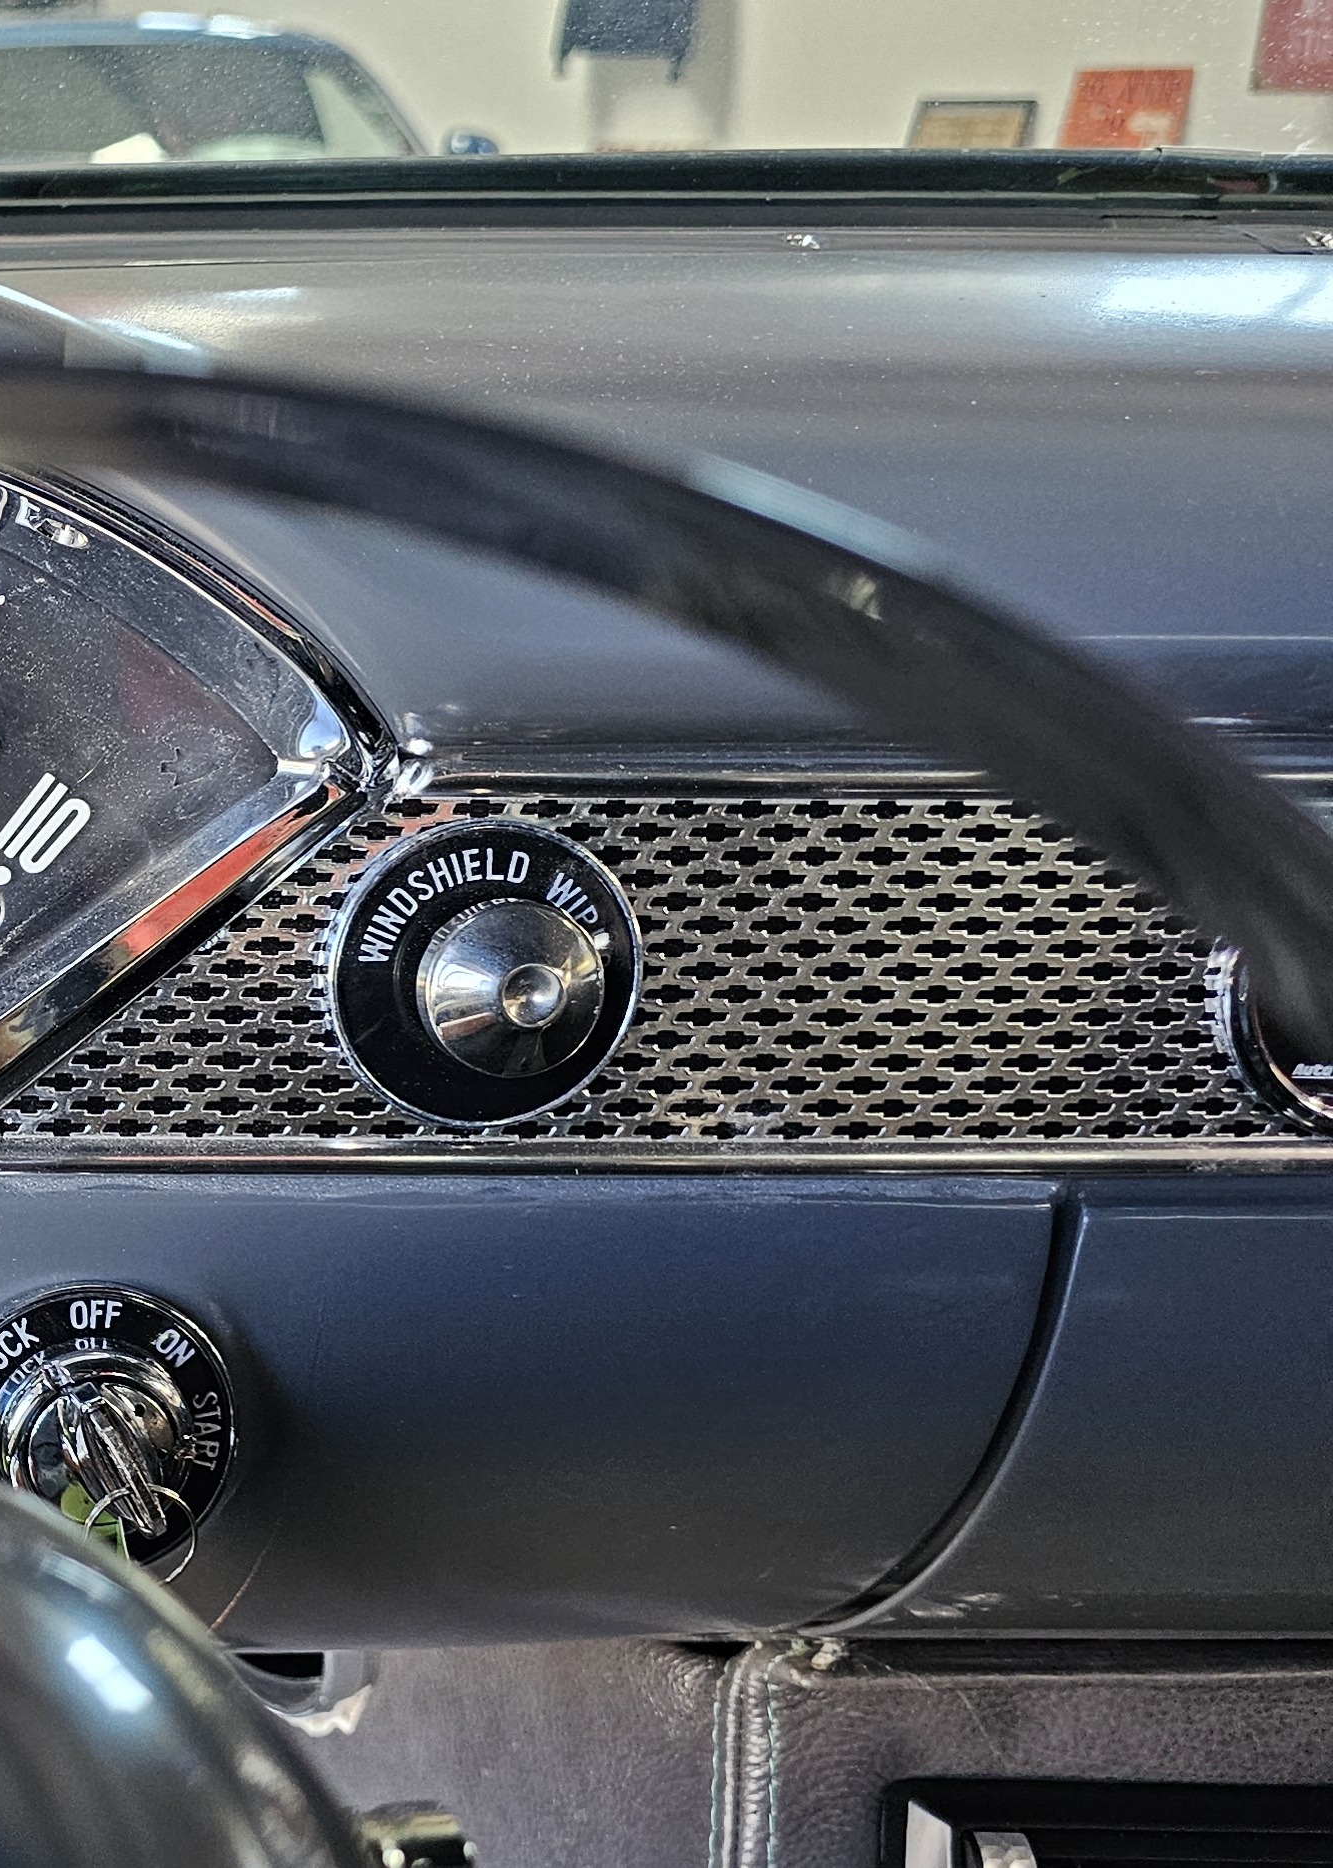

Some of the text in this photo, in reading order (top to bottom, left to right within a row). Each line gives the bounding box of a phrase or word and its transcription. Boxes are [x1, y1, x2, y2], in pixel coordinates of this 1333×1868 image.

[357, 847, 530, 962] WINDSHIELD
[69, 1299, 123, 1330] OFF
[154, 1327, 197, 1368] ON
[191, 1390, 222, 1472] START
